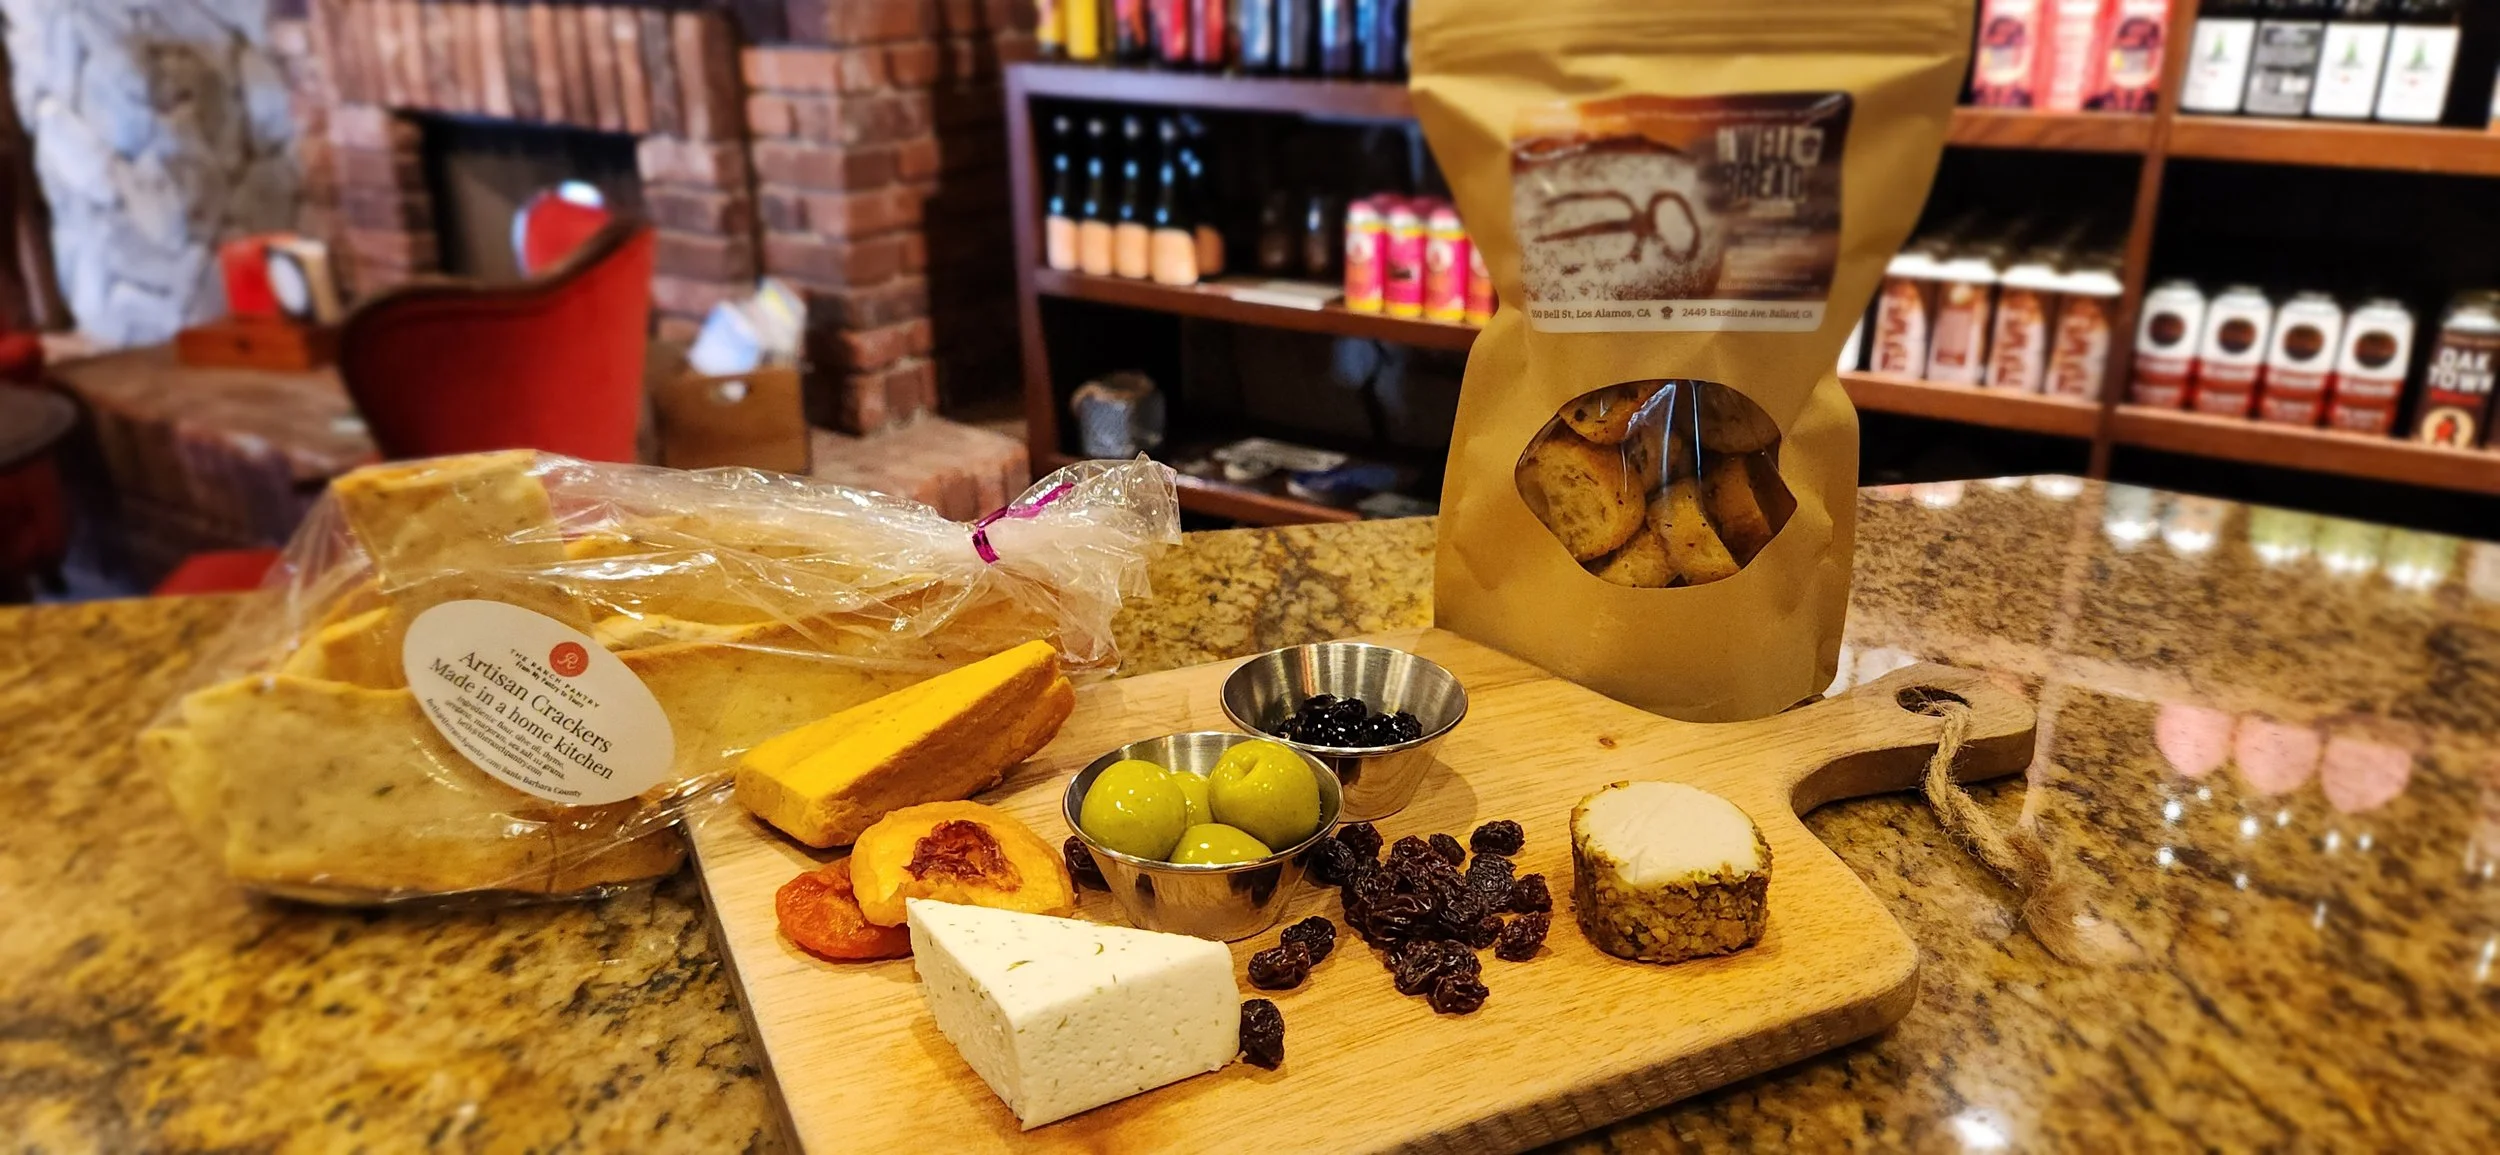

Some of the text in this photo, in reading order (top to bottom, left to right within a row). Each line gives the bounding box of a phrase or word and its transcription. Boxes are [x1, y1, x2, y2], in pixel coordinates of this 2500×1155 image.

[1544, 309, 1560, 319] Bell
[1561, 309, 1574, 319] St,
[1576, 309, 1592, 319] Los
[1594, 308, 1635, 319] Alamos,
[1636, 308, 1652, 318] CA
[1682, 308, 1708, 318] 2449
[1709, 307, 1748, 318] Baseline
[1769, 308, 1800, 319] Ballard,
[1801, 310, 1813, 319] CA
[510, 648, 601, 709] THE RANCH PANTRY
[428, 657, 614, 780] Made in a home kitchen
[458, 651, 614, 753] Artisan Crackers
[523, 775, 553, 794] Barbara
